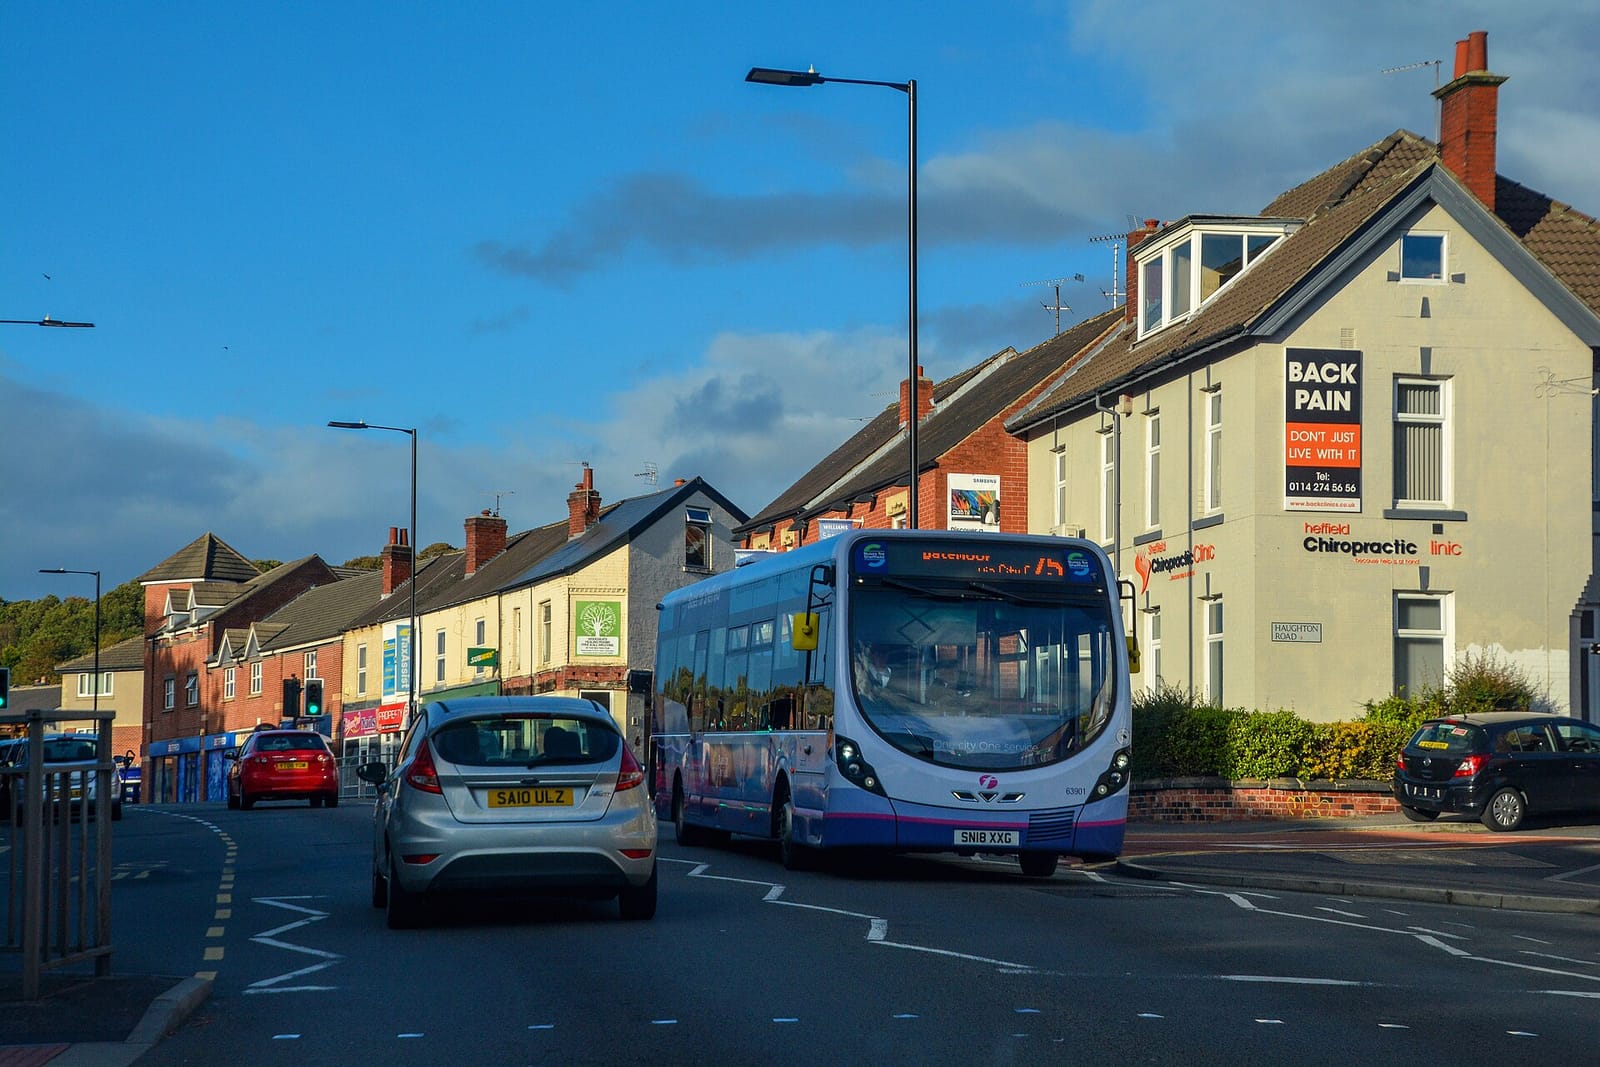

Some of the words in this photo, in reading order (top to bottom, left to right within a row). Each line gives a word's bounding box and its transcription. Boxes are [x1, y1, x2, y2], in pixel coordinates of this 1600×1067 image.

[1288, 361, 1357, 384] BACK
[1295, 389, 1351, 411] PAIN
[1290, 430, 1326, 442] DON'T
[1331, 432, 1355, 443] JUST
[1289, 448, 1311, 459] LIVE
[1317, 449, 1343, 460] WITH
[1348, 449, 1356, 460] IT
[1316, 471, 1330, 481] Tel:
[1289, 482, 1311, 491] 0114
[1313, 483, 1330, 492] 274
[1332, 483, 1343, 492] 56
[1345, 484, 1356, 492] 56
[1303, 536, 1418, 557] Chiropractic
[1274, 624, 1319, 632] HAUGHTON
[1275, 632, 1297, 640] ROAD
[1065, 787, 1086, 795] 63901
[497, 791, 531, 805] SA10
[535, 790, 565, 804] ULZ
[961, 832, 986, 843] SN18
[990, 833, 1012, 844] XXG
